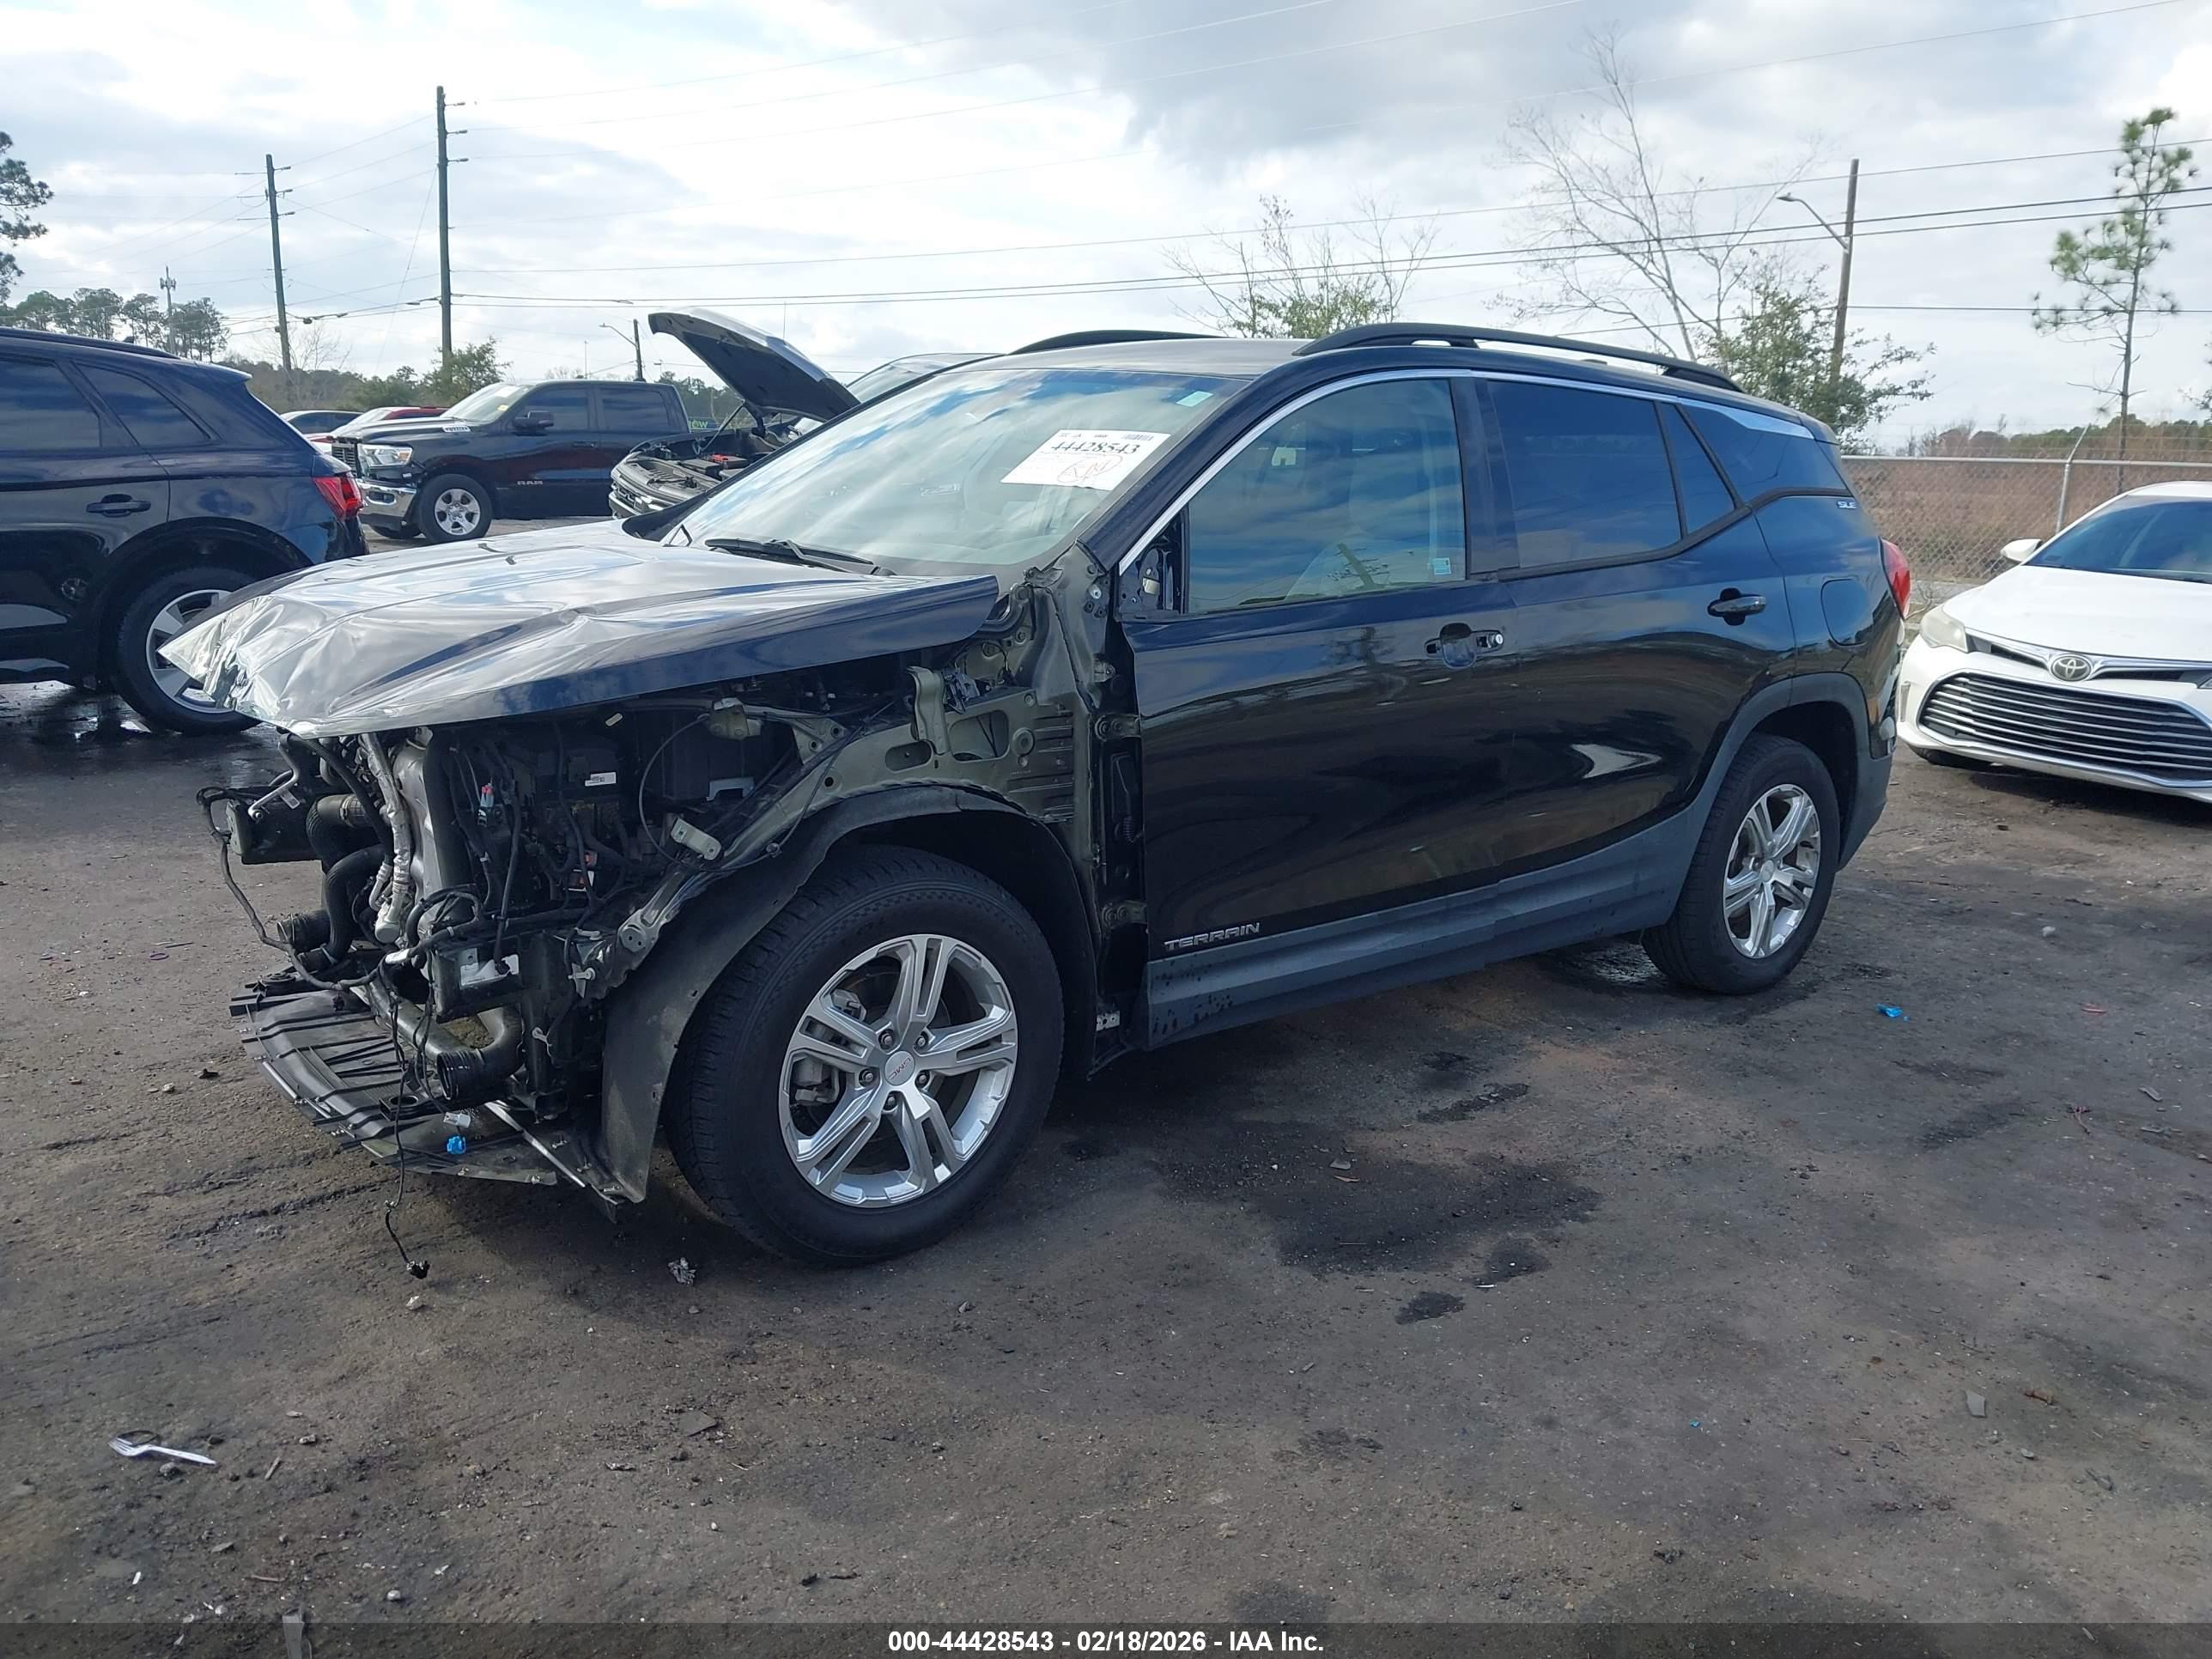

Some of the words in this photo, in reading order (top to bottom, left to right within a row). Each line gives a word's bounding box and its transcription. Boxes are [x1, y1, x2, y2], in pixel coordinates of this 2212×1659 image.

[1051, 441, 1140, 454] 44428543
[1164, 922, 1261, 951] TERRAIN
[888, 1057, 913, 1080] GMC
